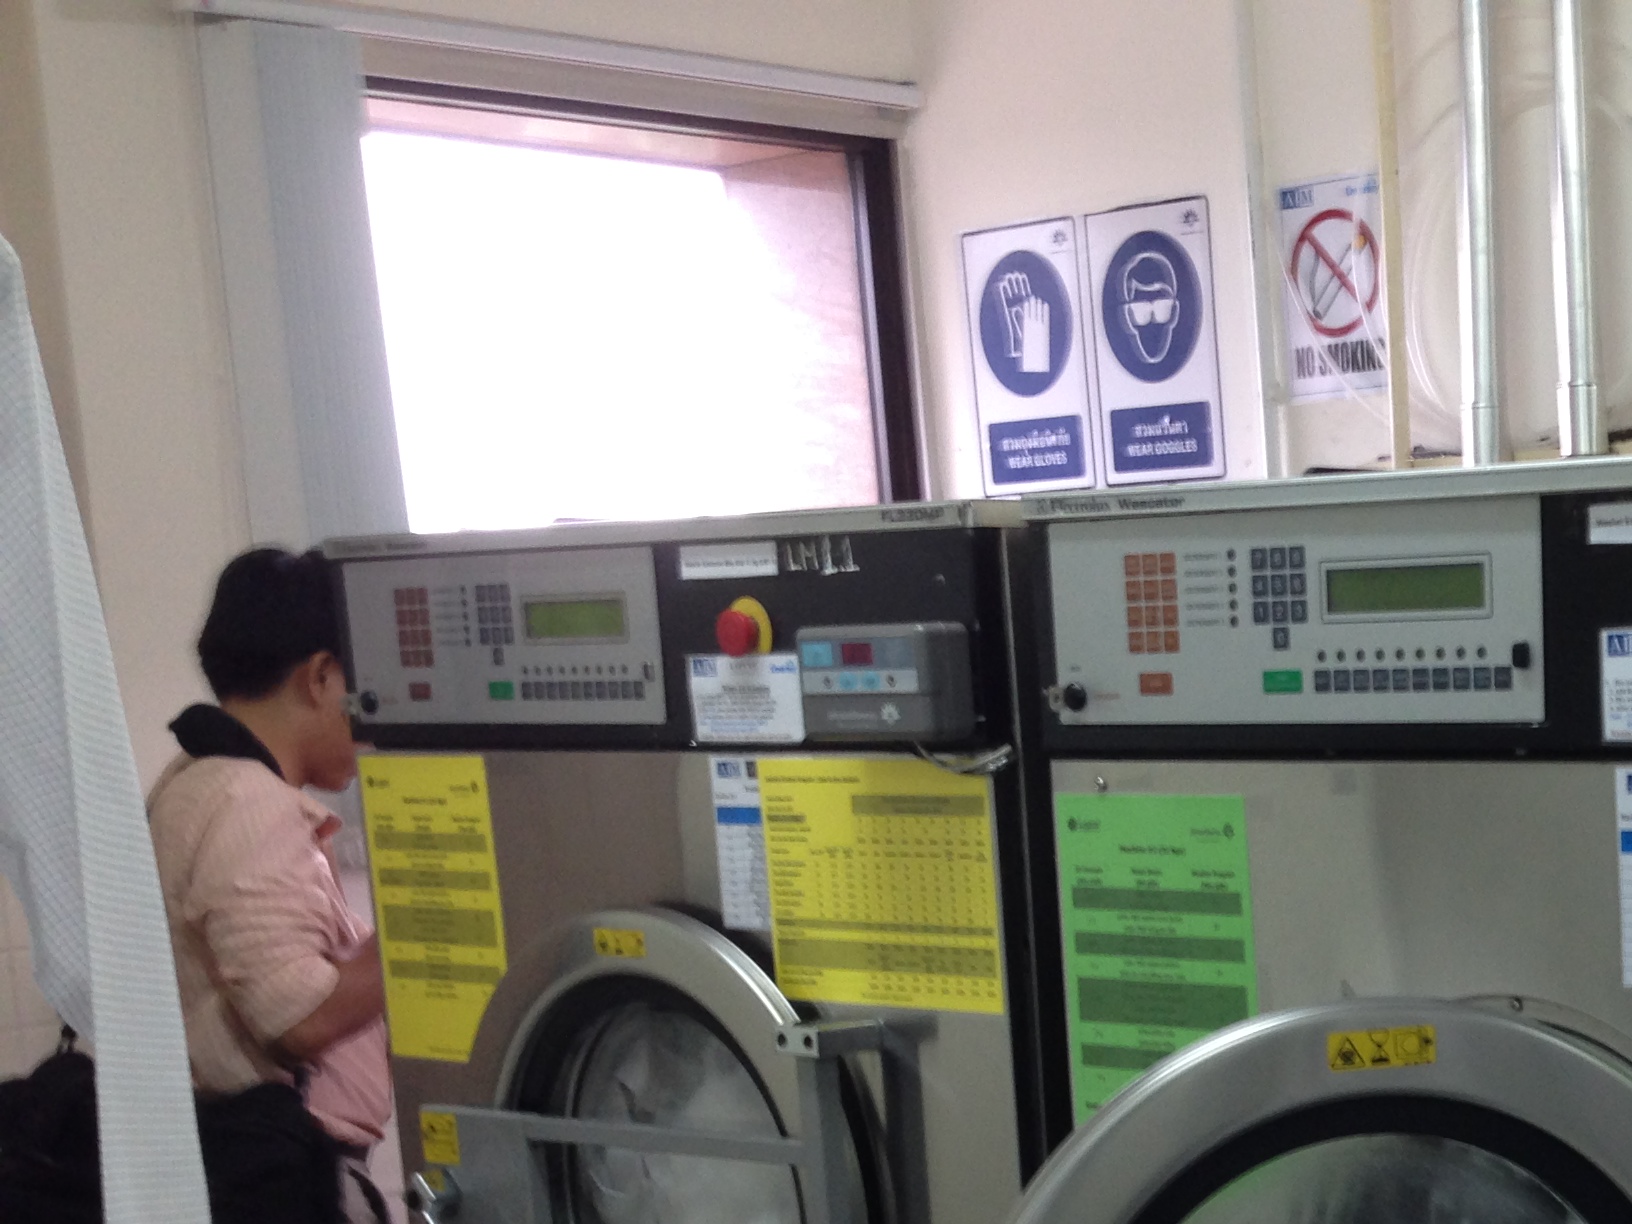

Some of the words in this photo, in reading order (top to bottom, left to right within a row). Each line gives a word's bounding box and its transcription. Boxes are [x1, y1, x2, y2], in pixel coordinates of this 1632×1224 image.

[1295, 346, 1315, 379] NO
[1126, 443, 1155, 458] WEAR
[1155, 438, 1199, 455] GOGGLES
[1008, 455, 1034, 469] WEAR
[1034, 451, 1069, 467] GLOVES
